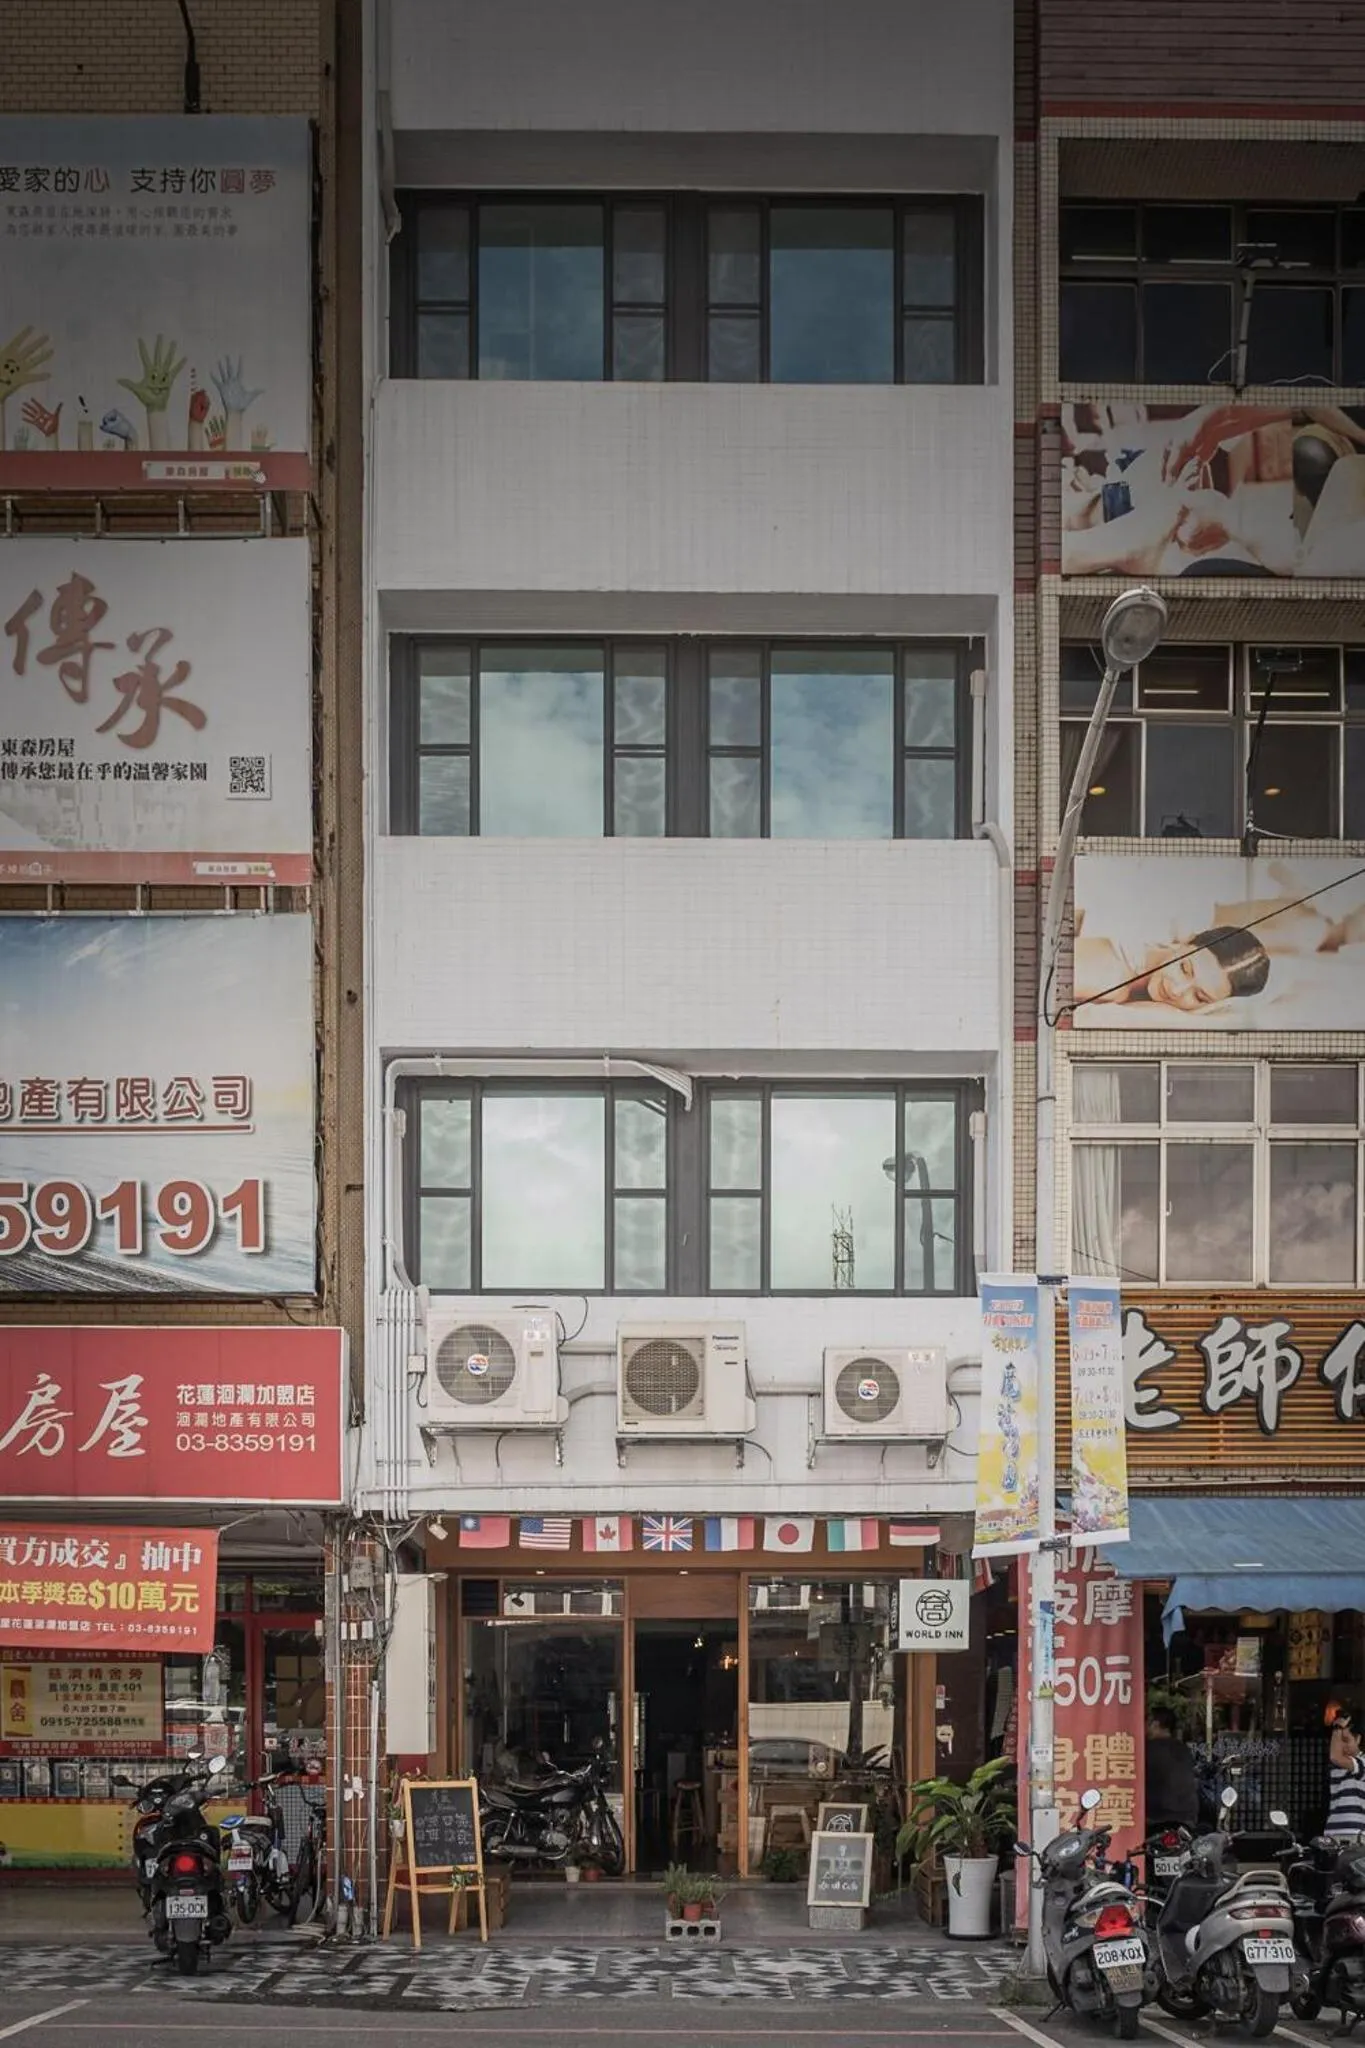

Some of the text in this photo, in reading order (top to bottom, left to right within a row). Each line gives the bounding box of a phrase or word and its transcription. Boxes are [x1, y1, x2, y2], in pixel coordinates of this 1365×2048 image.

[1, 738, 75, 758] 東森房屋
[1, 762, 207, 782] 傳承您最在乎的溫馨家園
[0, 1075, 253, 1120] 產有限公司
[176, 1383, 316, 1407] 花蓮洄瀾加盟店
[176, 1410, 316, 1429] 洄瀾地產有限公司
[175, 1433, 317, 1453] 03-8359191
[905, 1629, 963, 1639] WORLD INN
